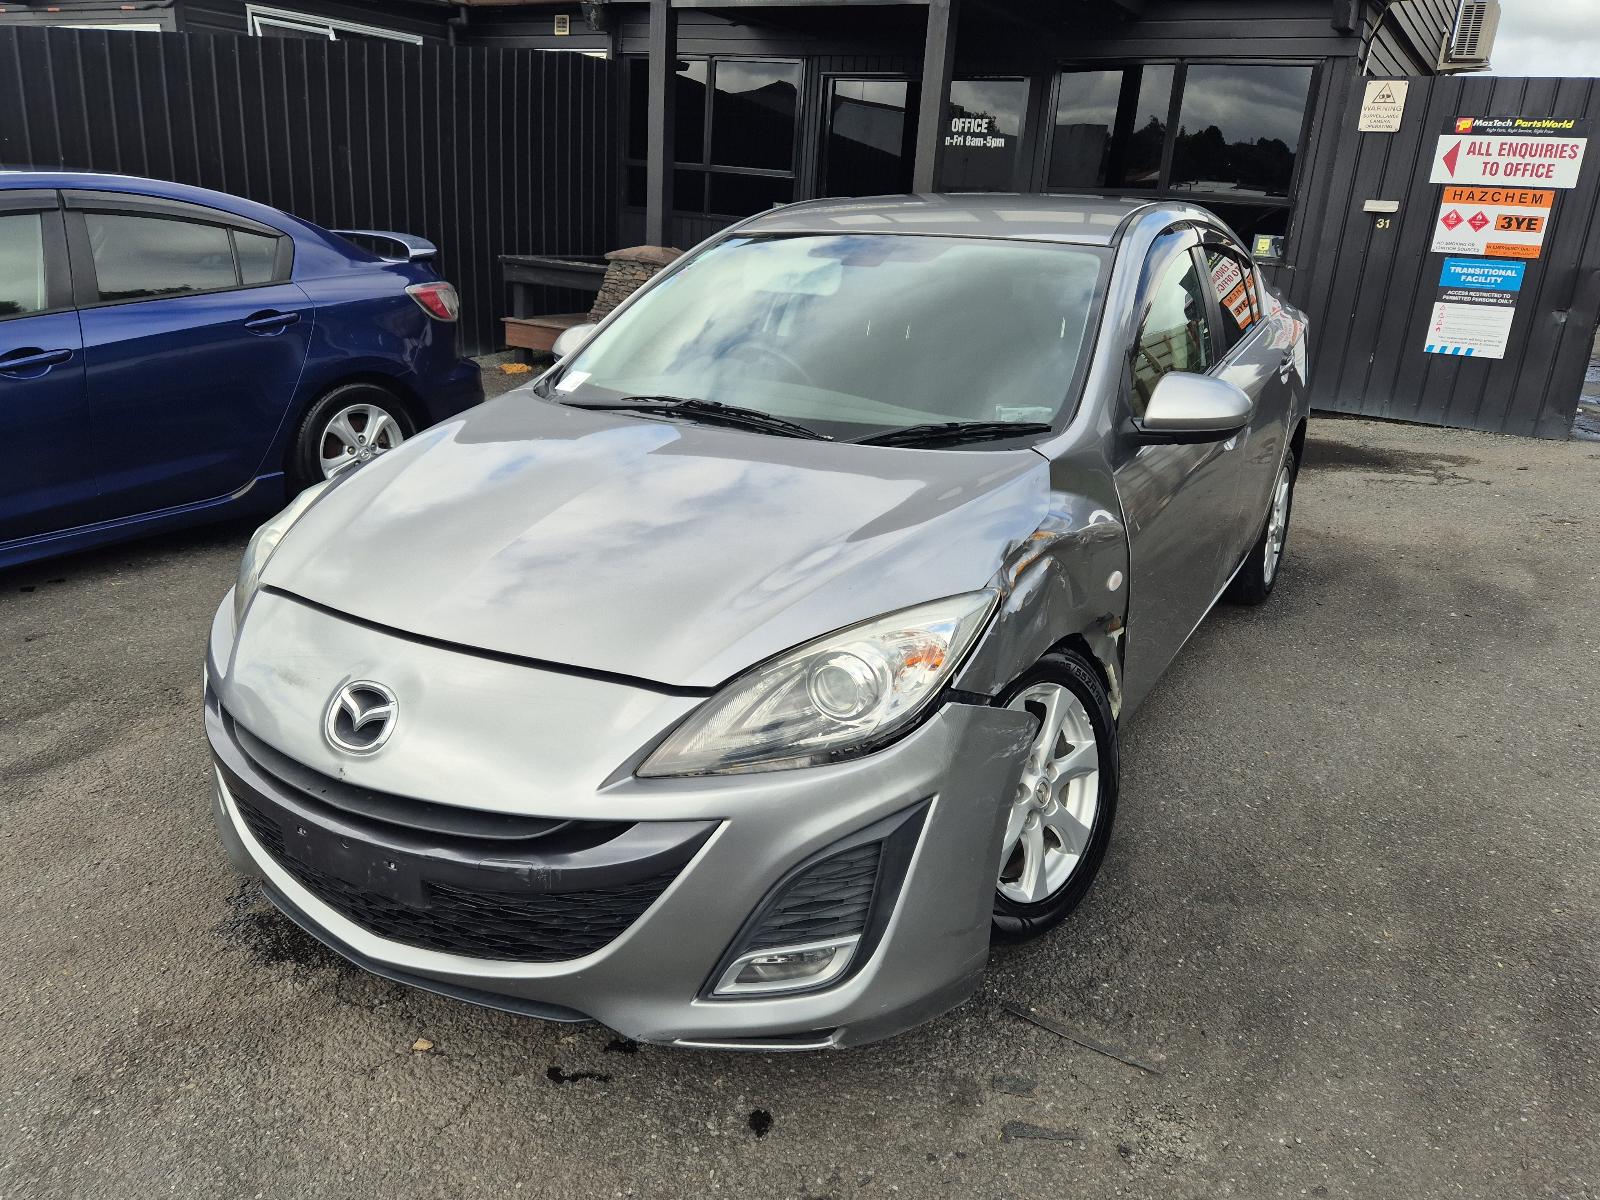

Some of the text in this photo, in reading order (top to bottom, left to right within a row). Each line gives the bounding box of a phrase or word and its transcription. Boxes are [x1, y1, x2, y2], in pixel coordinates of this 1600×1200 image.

[951, 118, 989, 133] OFFICE
[1514, 120, 1575, 128] PartsWorld
[966, 136, 1005, 148] 8am-5pm
[1466, 141, 1579, 160] ALL ENQUIRIES
[1482, 161, 1555, 179] TO OFFICE
[1453, 190, 1544, 204] HAZCHEM
[1376, 219, 1390, 229] 31
[1501, 216, 1538, 231] 3YE
[1449, 267, 1517, 277] TRANSITIONAL
[1461, 275, 1503, 283] FACILITY
